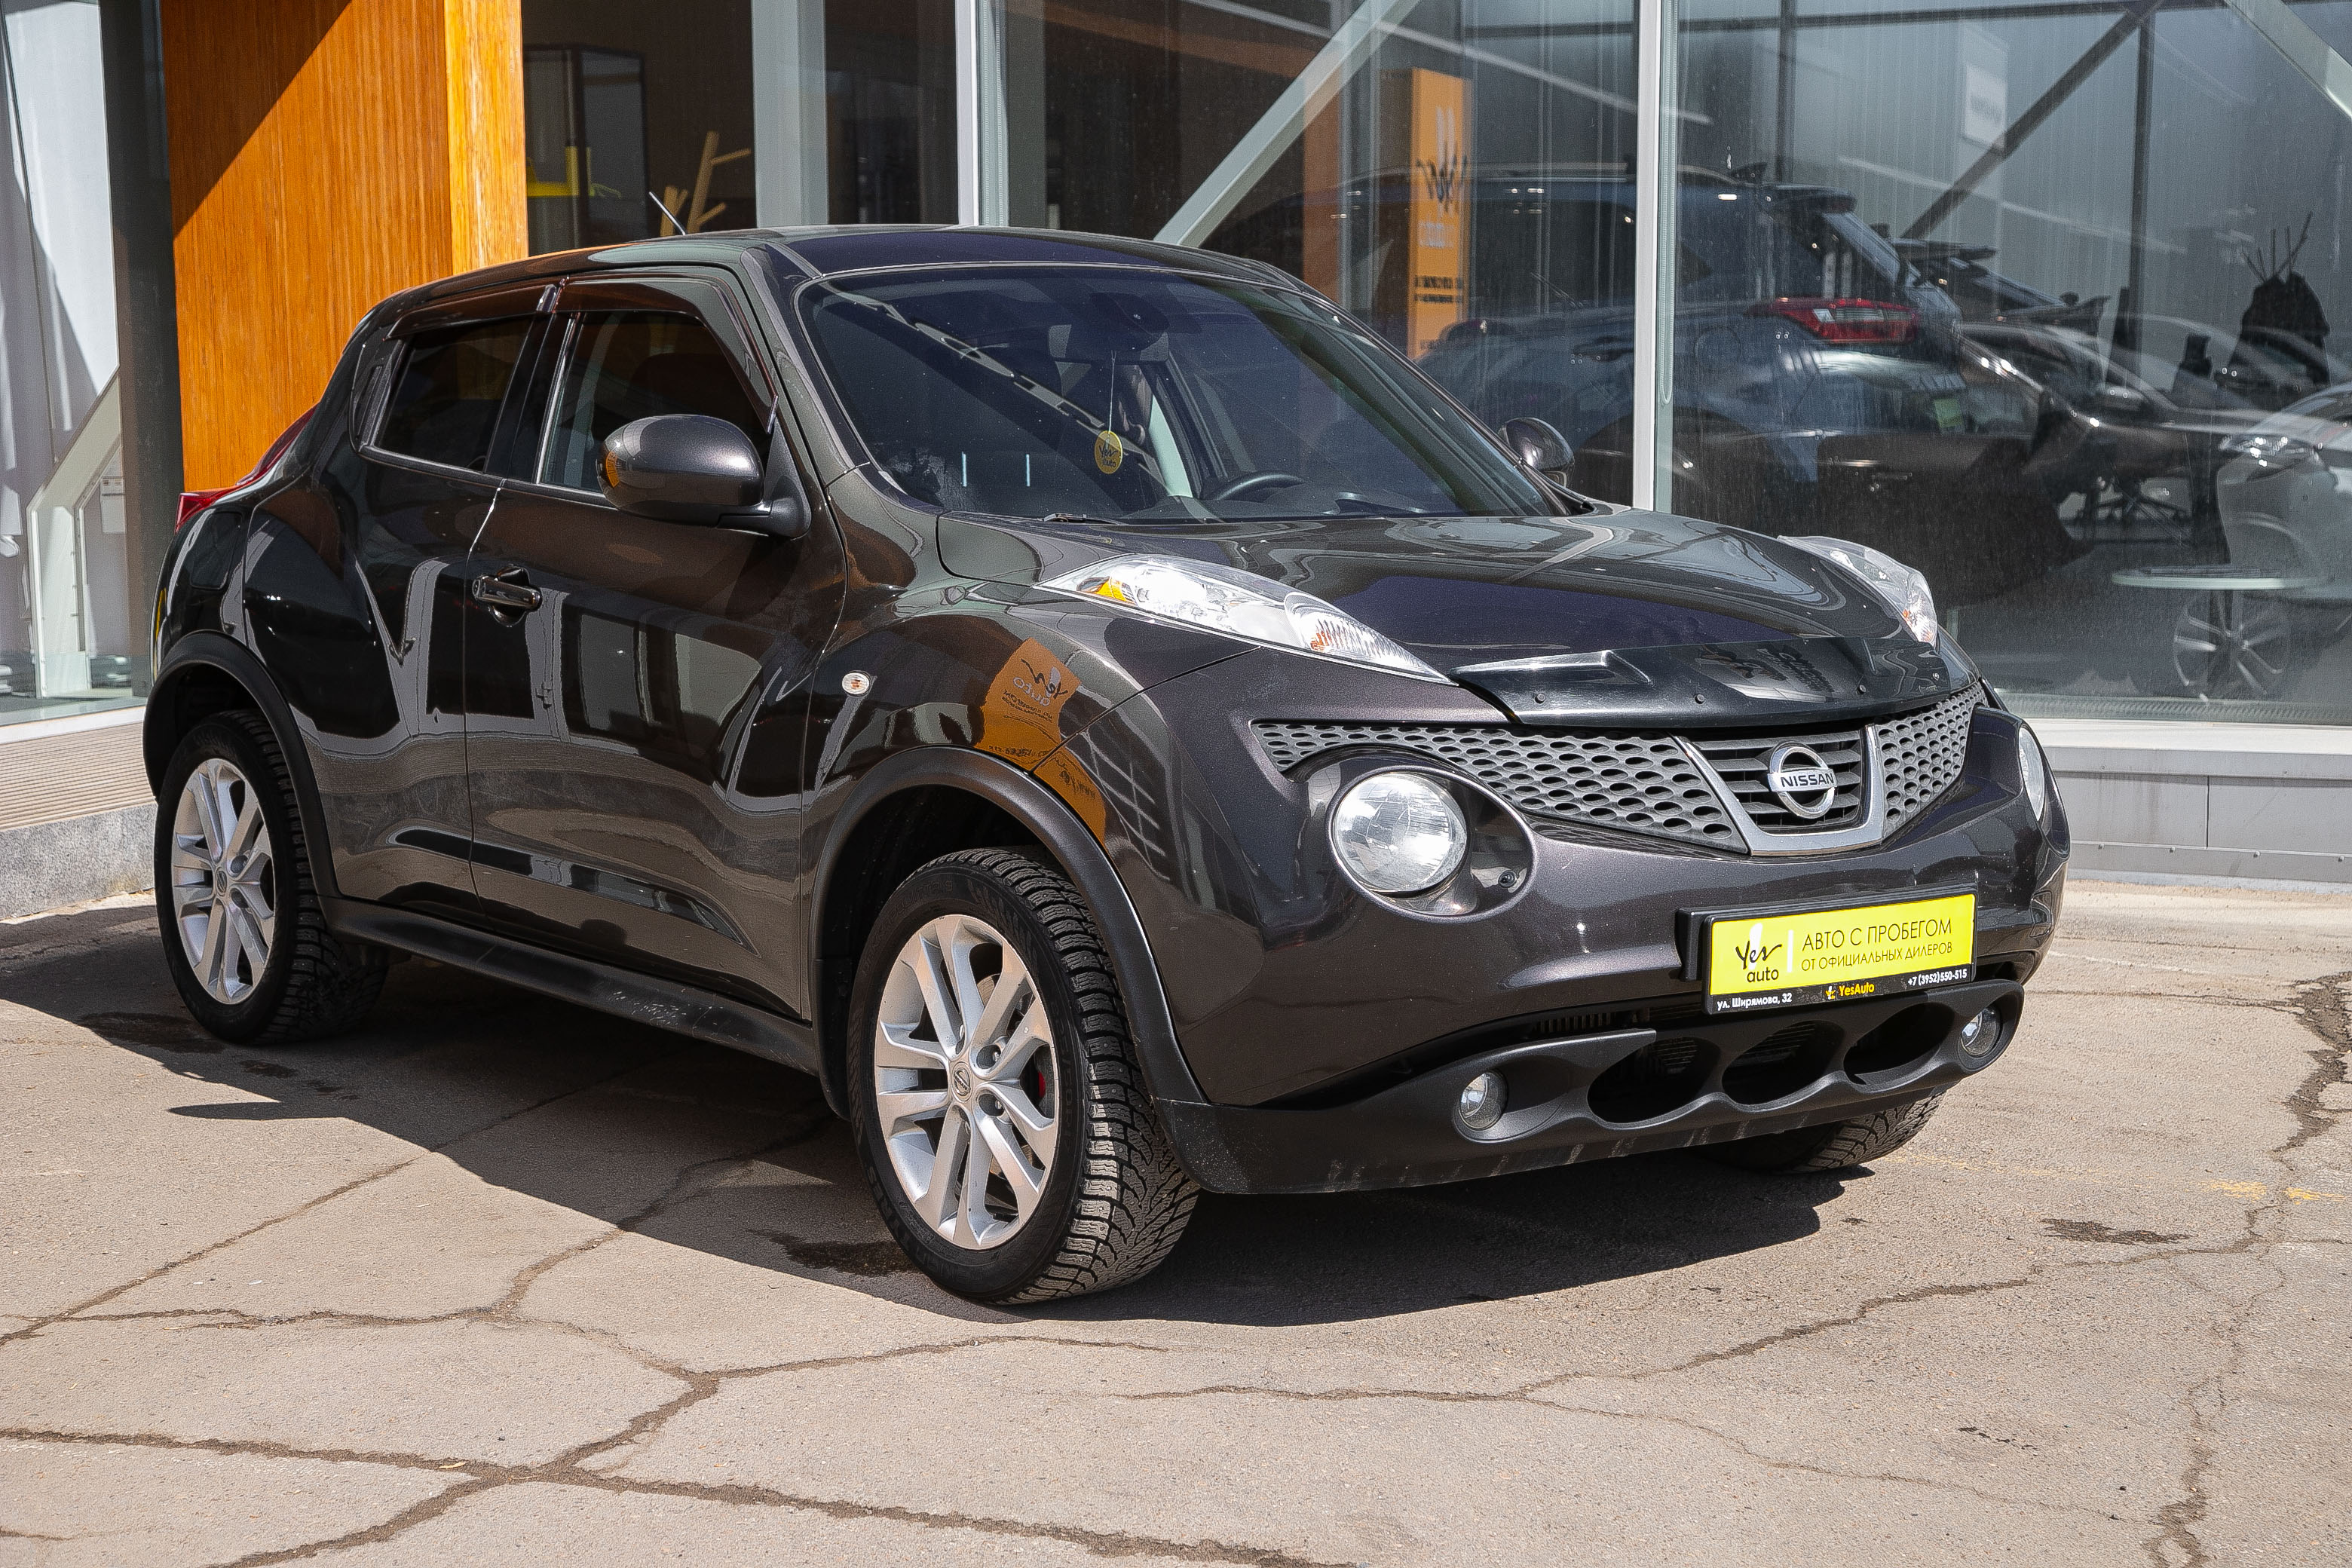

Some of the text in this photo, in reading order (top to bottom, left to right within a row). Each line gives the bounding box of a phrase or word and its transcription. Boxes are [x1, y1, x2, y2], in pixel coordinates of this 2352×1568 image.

[1781, 773, 1834, 788] NISSAN
[1802, 917, 1952, 951] АВТО С ПРОБЕГОМ
[1735, 940, 1782, 969] Yes
[1801, 942, 1952, 971] ОТ ОФИЦИАЛЬНЫХ ДИЛЕРОВ
[1747, 967, 1779, 983] auto
[1838, 982, 1875, 997] YesAuto
[1717, 992, 1793, 1011] ул. Ширямова, 32
